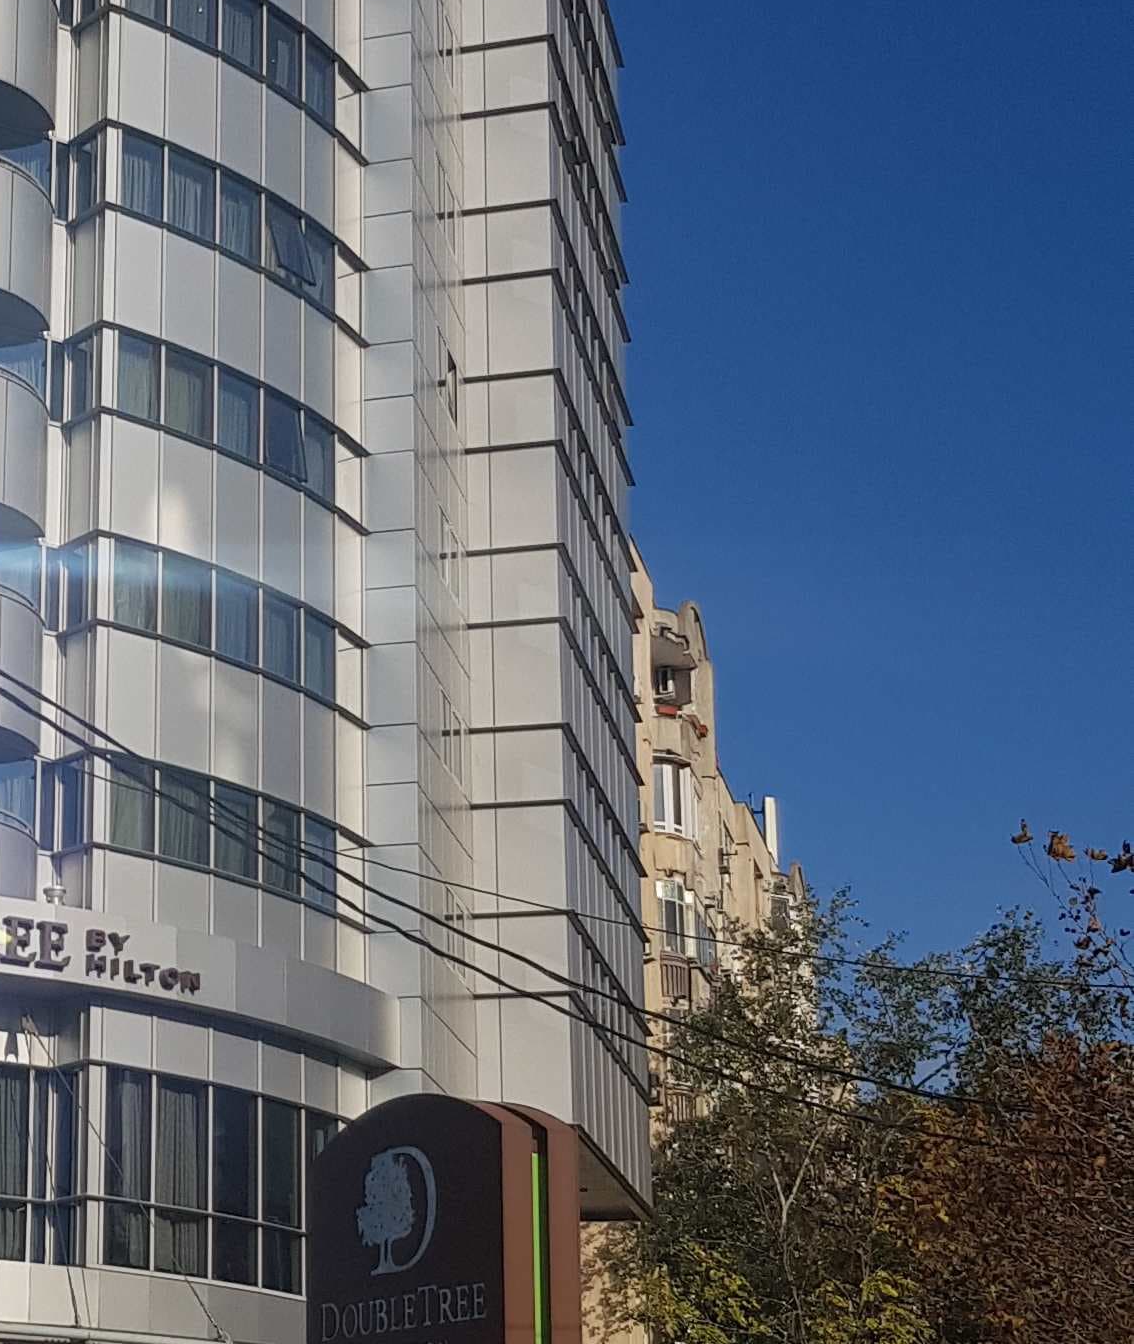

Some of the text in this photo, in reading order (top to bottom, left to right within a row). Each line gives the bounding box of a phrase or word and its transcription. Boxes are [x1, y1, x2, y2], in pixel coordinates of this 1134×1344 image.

[85, 928, 130, 956] BY
[85, 954, 201, 996] HILTON
[321, 1282, 487, 1342] DOUBLETREE
